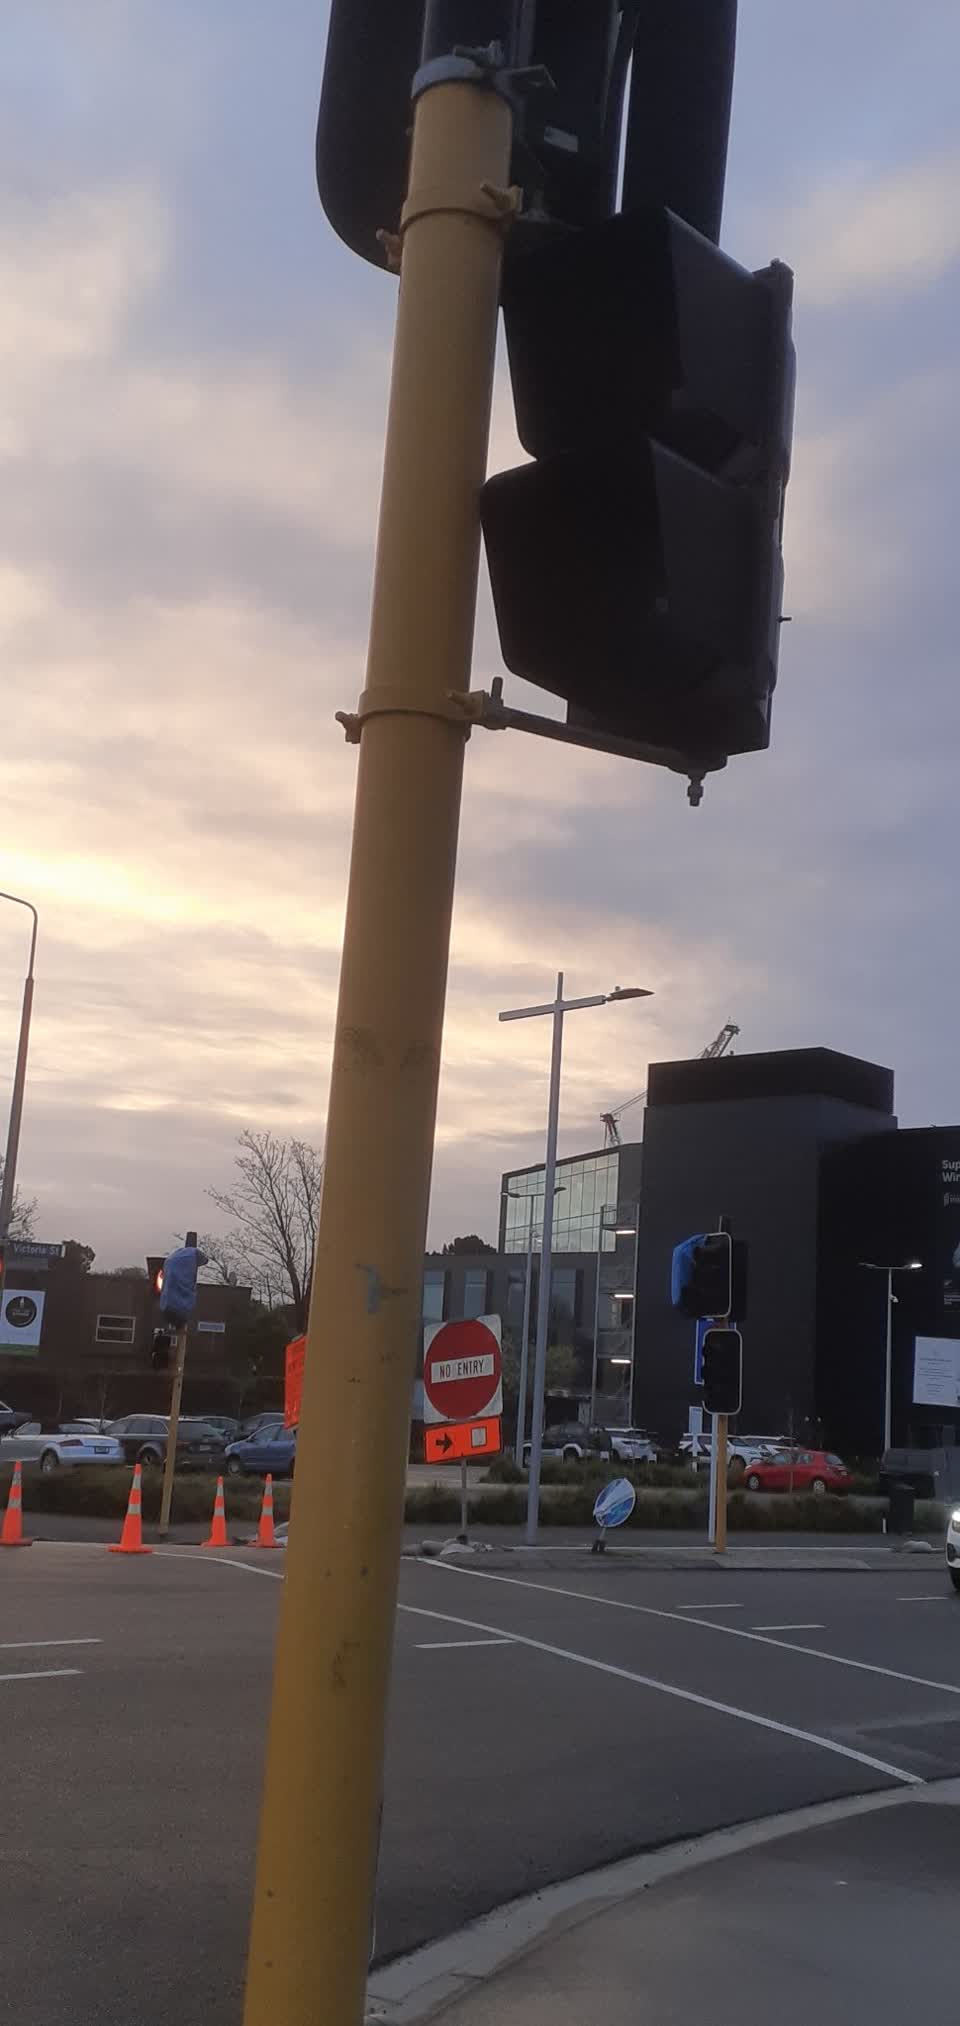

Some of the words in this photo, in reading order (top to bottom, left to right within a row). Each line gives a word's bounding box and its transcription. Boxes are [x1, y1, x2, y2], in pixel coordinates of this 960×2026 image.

[14, 1244, 47, 1254] Victoria
[49, 1246, 59, 1256] St
[440, 1364, 451, 1378] NO
[457, 1359, 484, 1376] ENTRY
